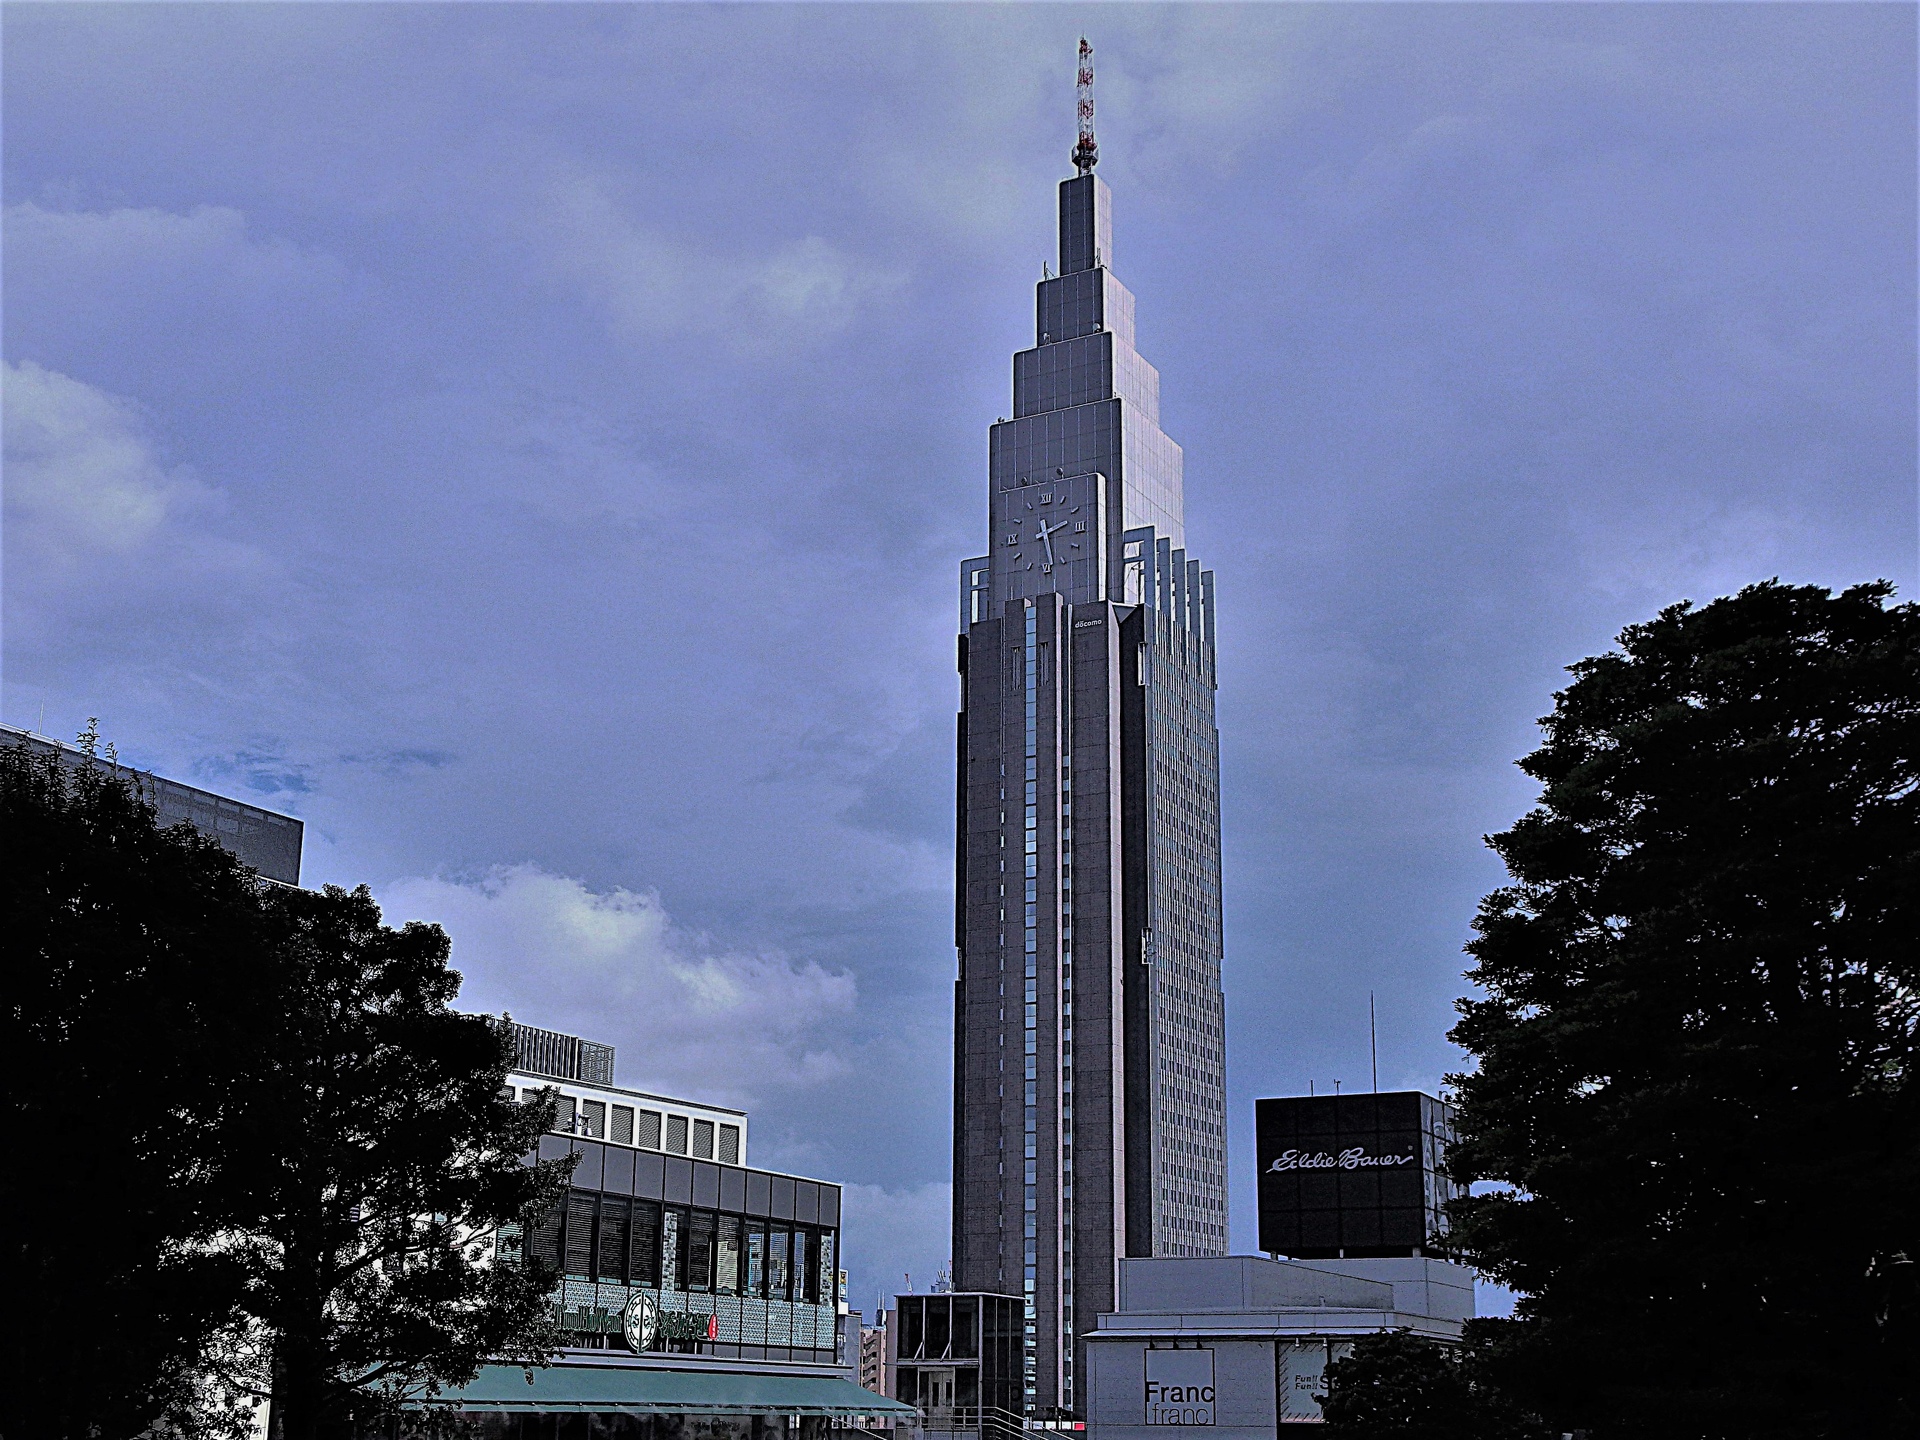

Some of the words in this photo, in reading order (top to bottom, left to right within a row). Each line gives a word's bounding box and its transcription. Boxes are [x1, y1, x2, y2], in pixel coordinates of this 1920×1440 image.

[1040, 493, 1052, 505] XII
[1075, 521, 1086, 532] III
[1007, 534, 1018, 545] IX
[1265, 1149, 1338, 1174] Eddie
[1338, 1147, 1414, 1170] Bauer
[1145, 1381, 1215, 1402] Franc
[1152, 1403, 1208, 1425] franc
